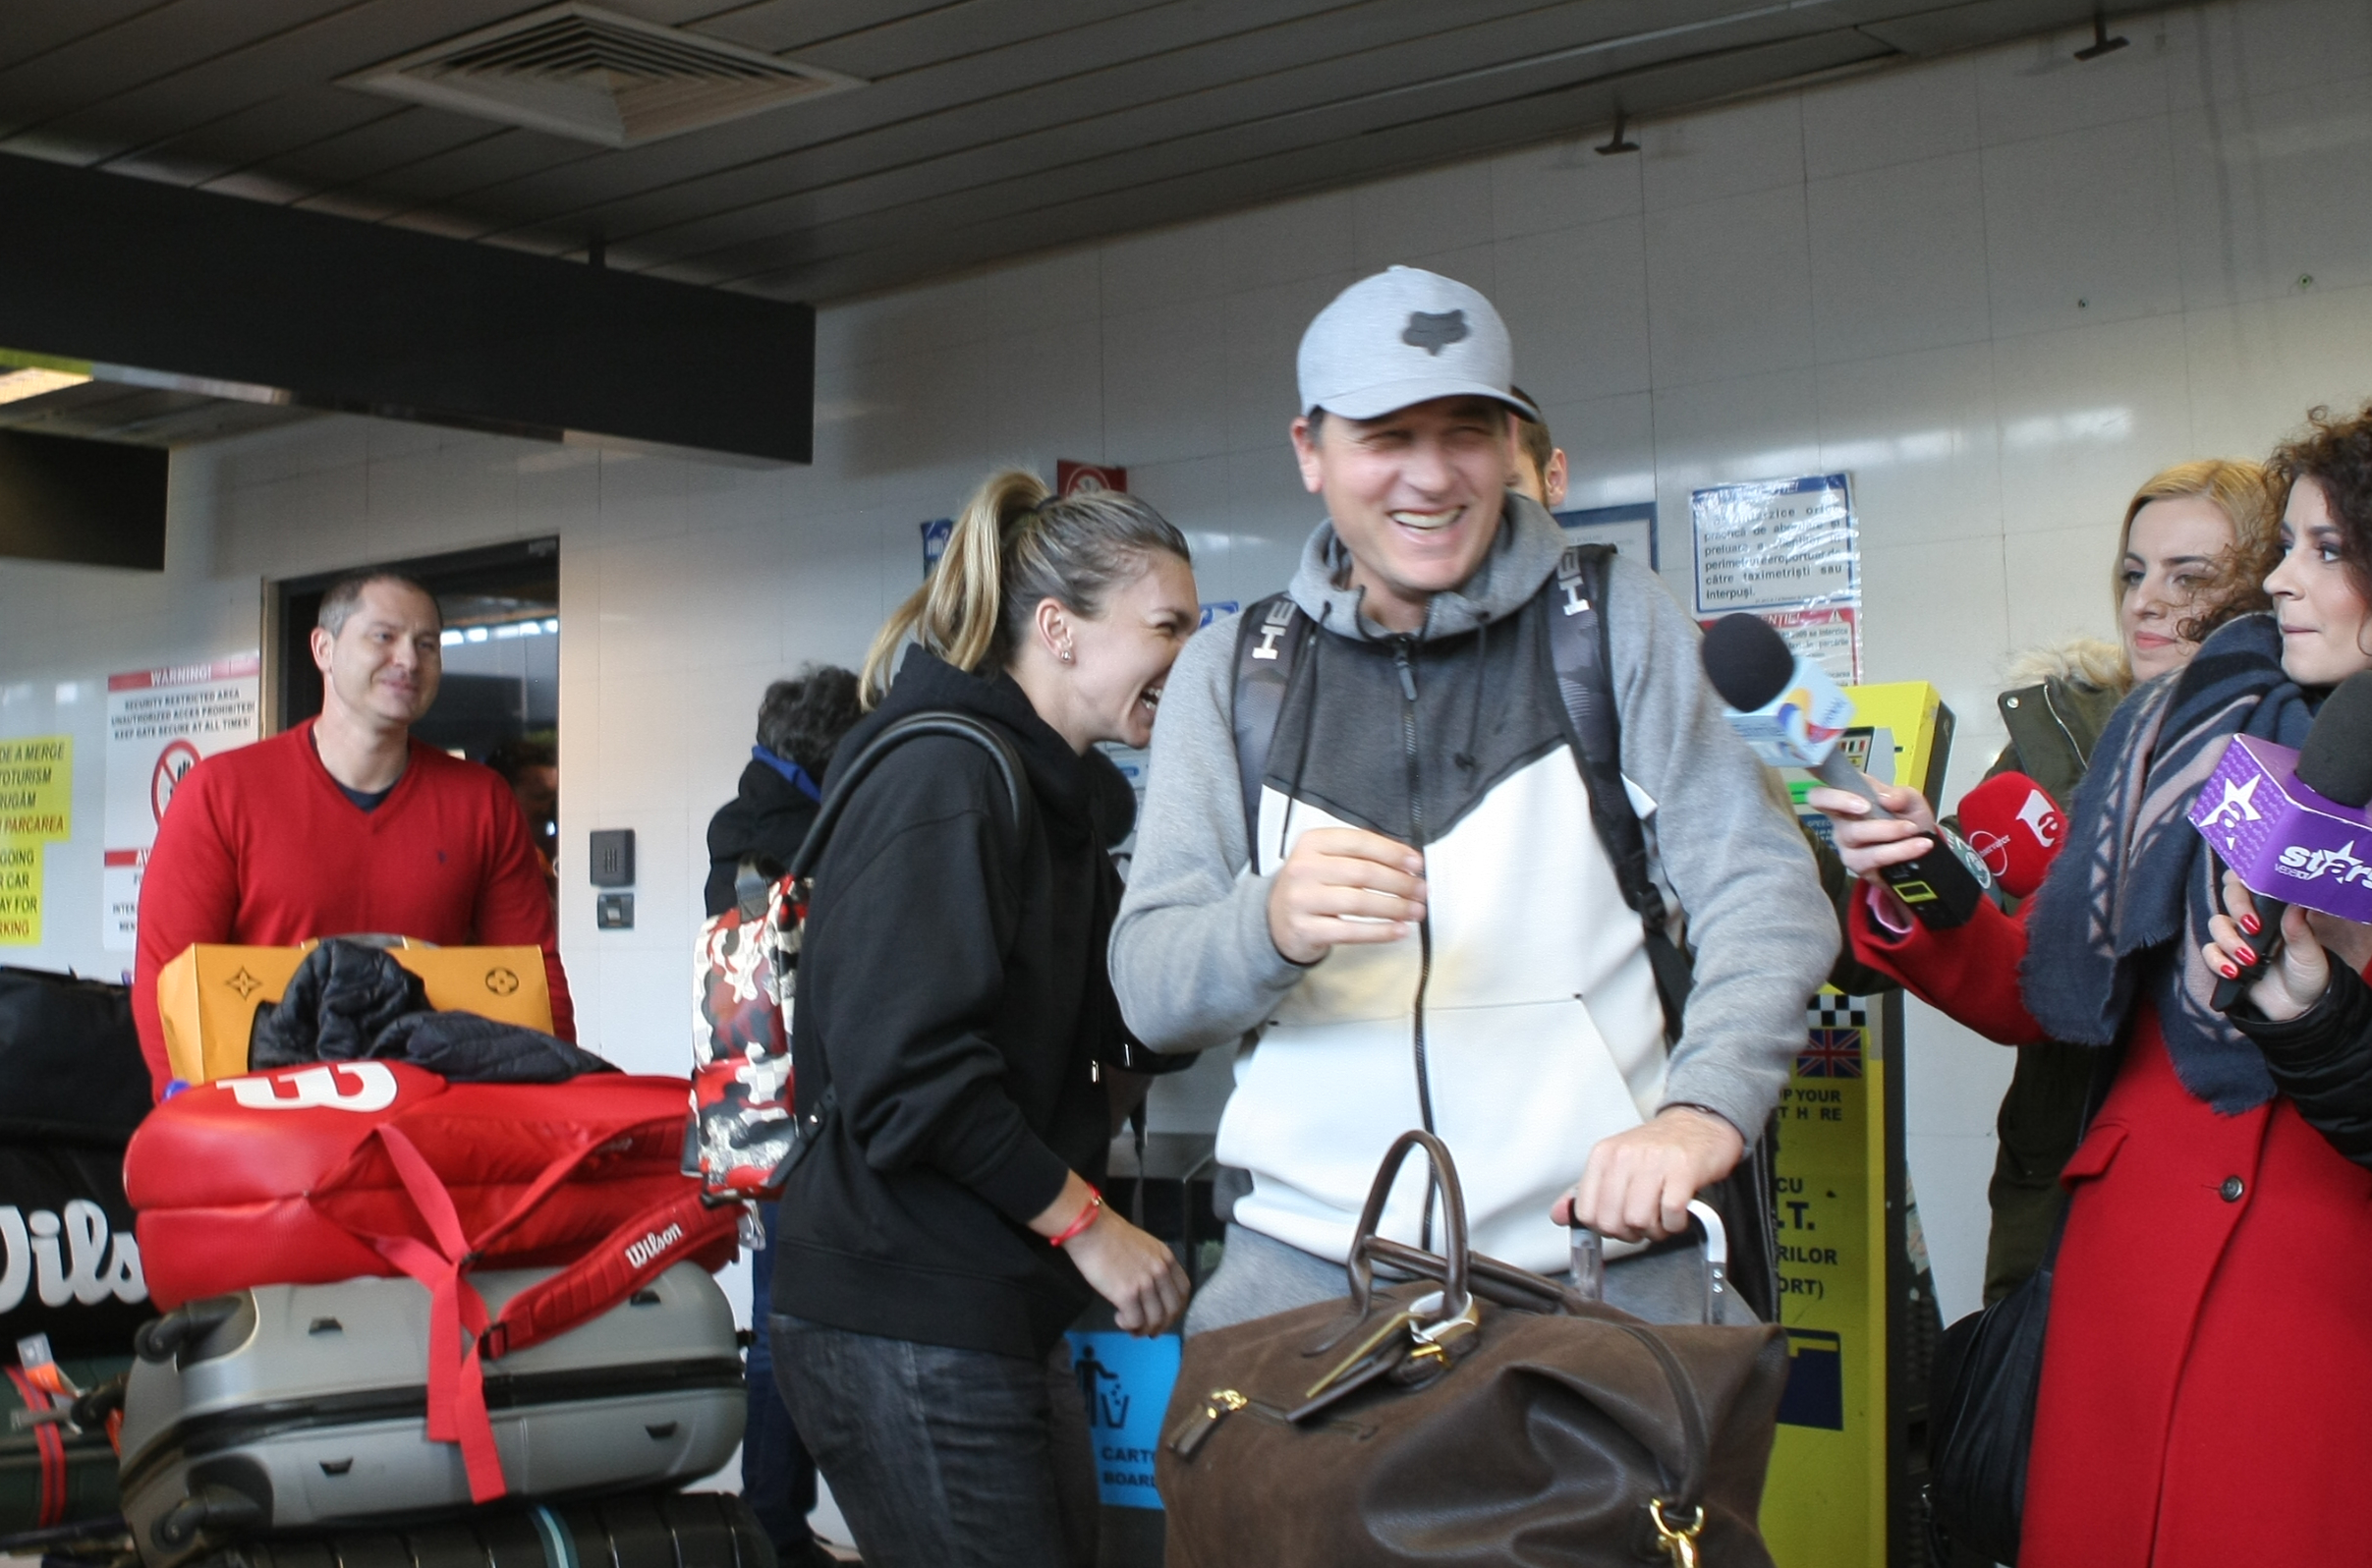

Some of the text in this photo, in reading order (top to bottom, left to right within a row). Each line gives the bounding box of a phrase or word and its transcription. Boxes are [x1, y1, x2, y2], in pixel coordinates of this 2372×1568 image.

[1753, 525, 1767, 535] de
[1821, 565, 1841, 574] sau
[150, 663, 212, 688] WARNING!
[124, 689, 241, 710] SECURITY RESTRICTED AREA
[111, 710, 172, 727] UNAUTHORIZED
[201, 700, 255, 716] PROHIBITED!
[158, 723, 190, 736] SECURE
[192, 722, 202, 733] AT
[204, 720, 219, 731] ALL
[25, 743, 65, 761] MERGE
[0, 767, 52, 786] OTURISM
[5, 814, 64, 834] PARCAREA
[15, 896, 37, 914] FOR
[1796, 1089, 1841, 1102] YOUR
[624, 1222, 684, 1269] Wilson
